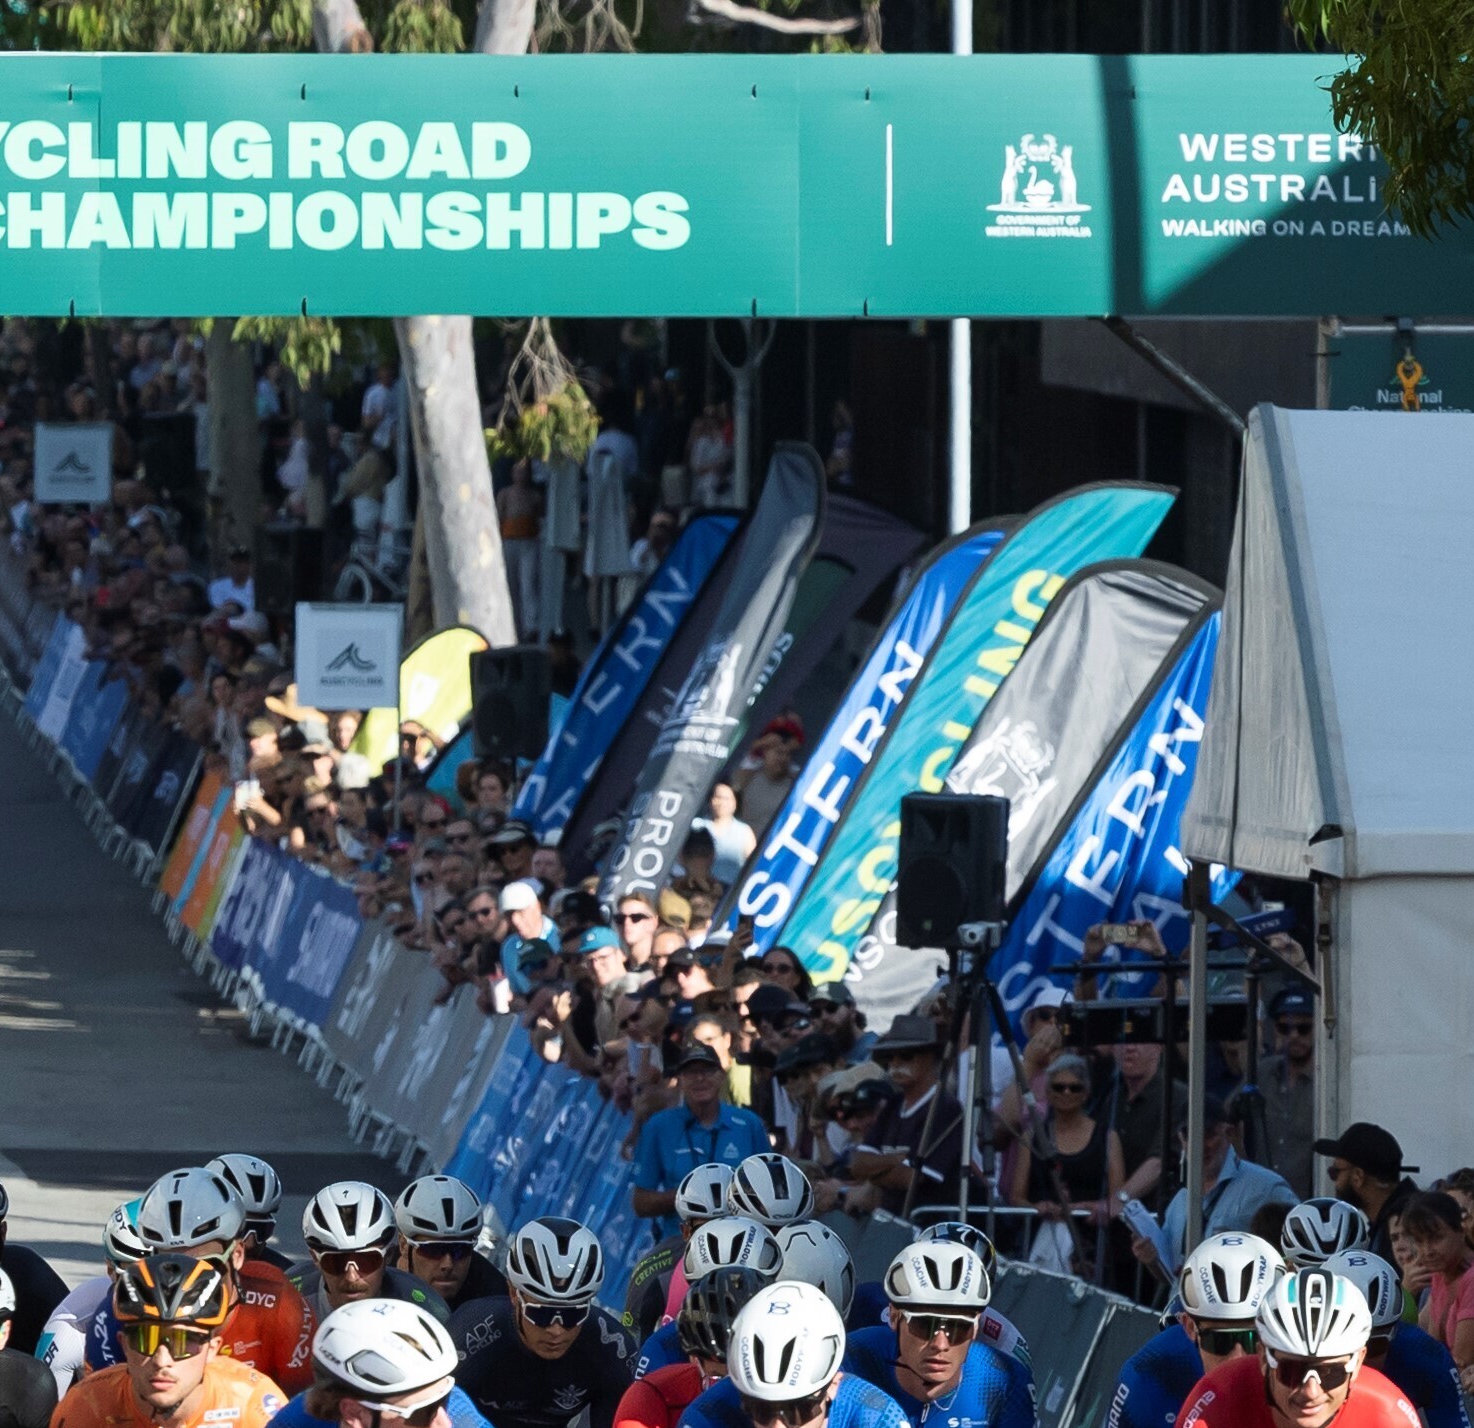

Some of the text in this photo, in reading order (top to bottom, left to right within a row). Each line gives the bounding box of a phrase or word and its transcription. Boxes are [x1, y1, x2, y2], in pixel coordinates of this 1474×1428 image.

[287, 120, 532, 180] ROAD
[1179, 133, 1377, 162] WESTER
[1161, 174, 1377, 203] AUSTRALI
[1161, 219, 1267, 237] WALKING
[1272, 220, 1306, 236] ON
[1311, 220, 1325, 236] A
[1377, 389, 1443, 404] Natnal
[738, 640, 924, 930] STERN
[997, 696, 1206, 1012] STERN
[634, 1257, 673, 1286] CREATIVE
[245, 1290, 276, 1308] DYC
[465, 1314, 496, 1349] ADF
